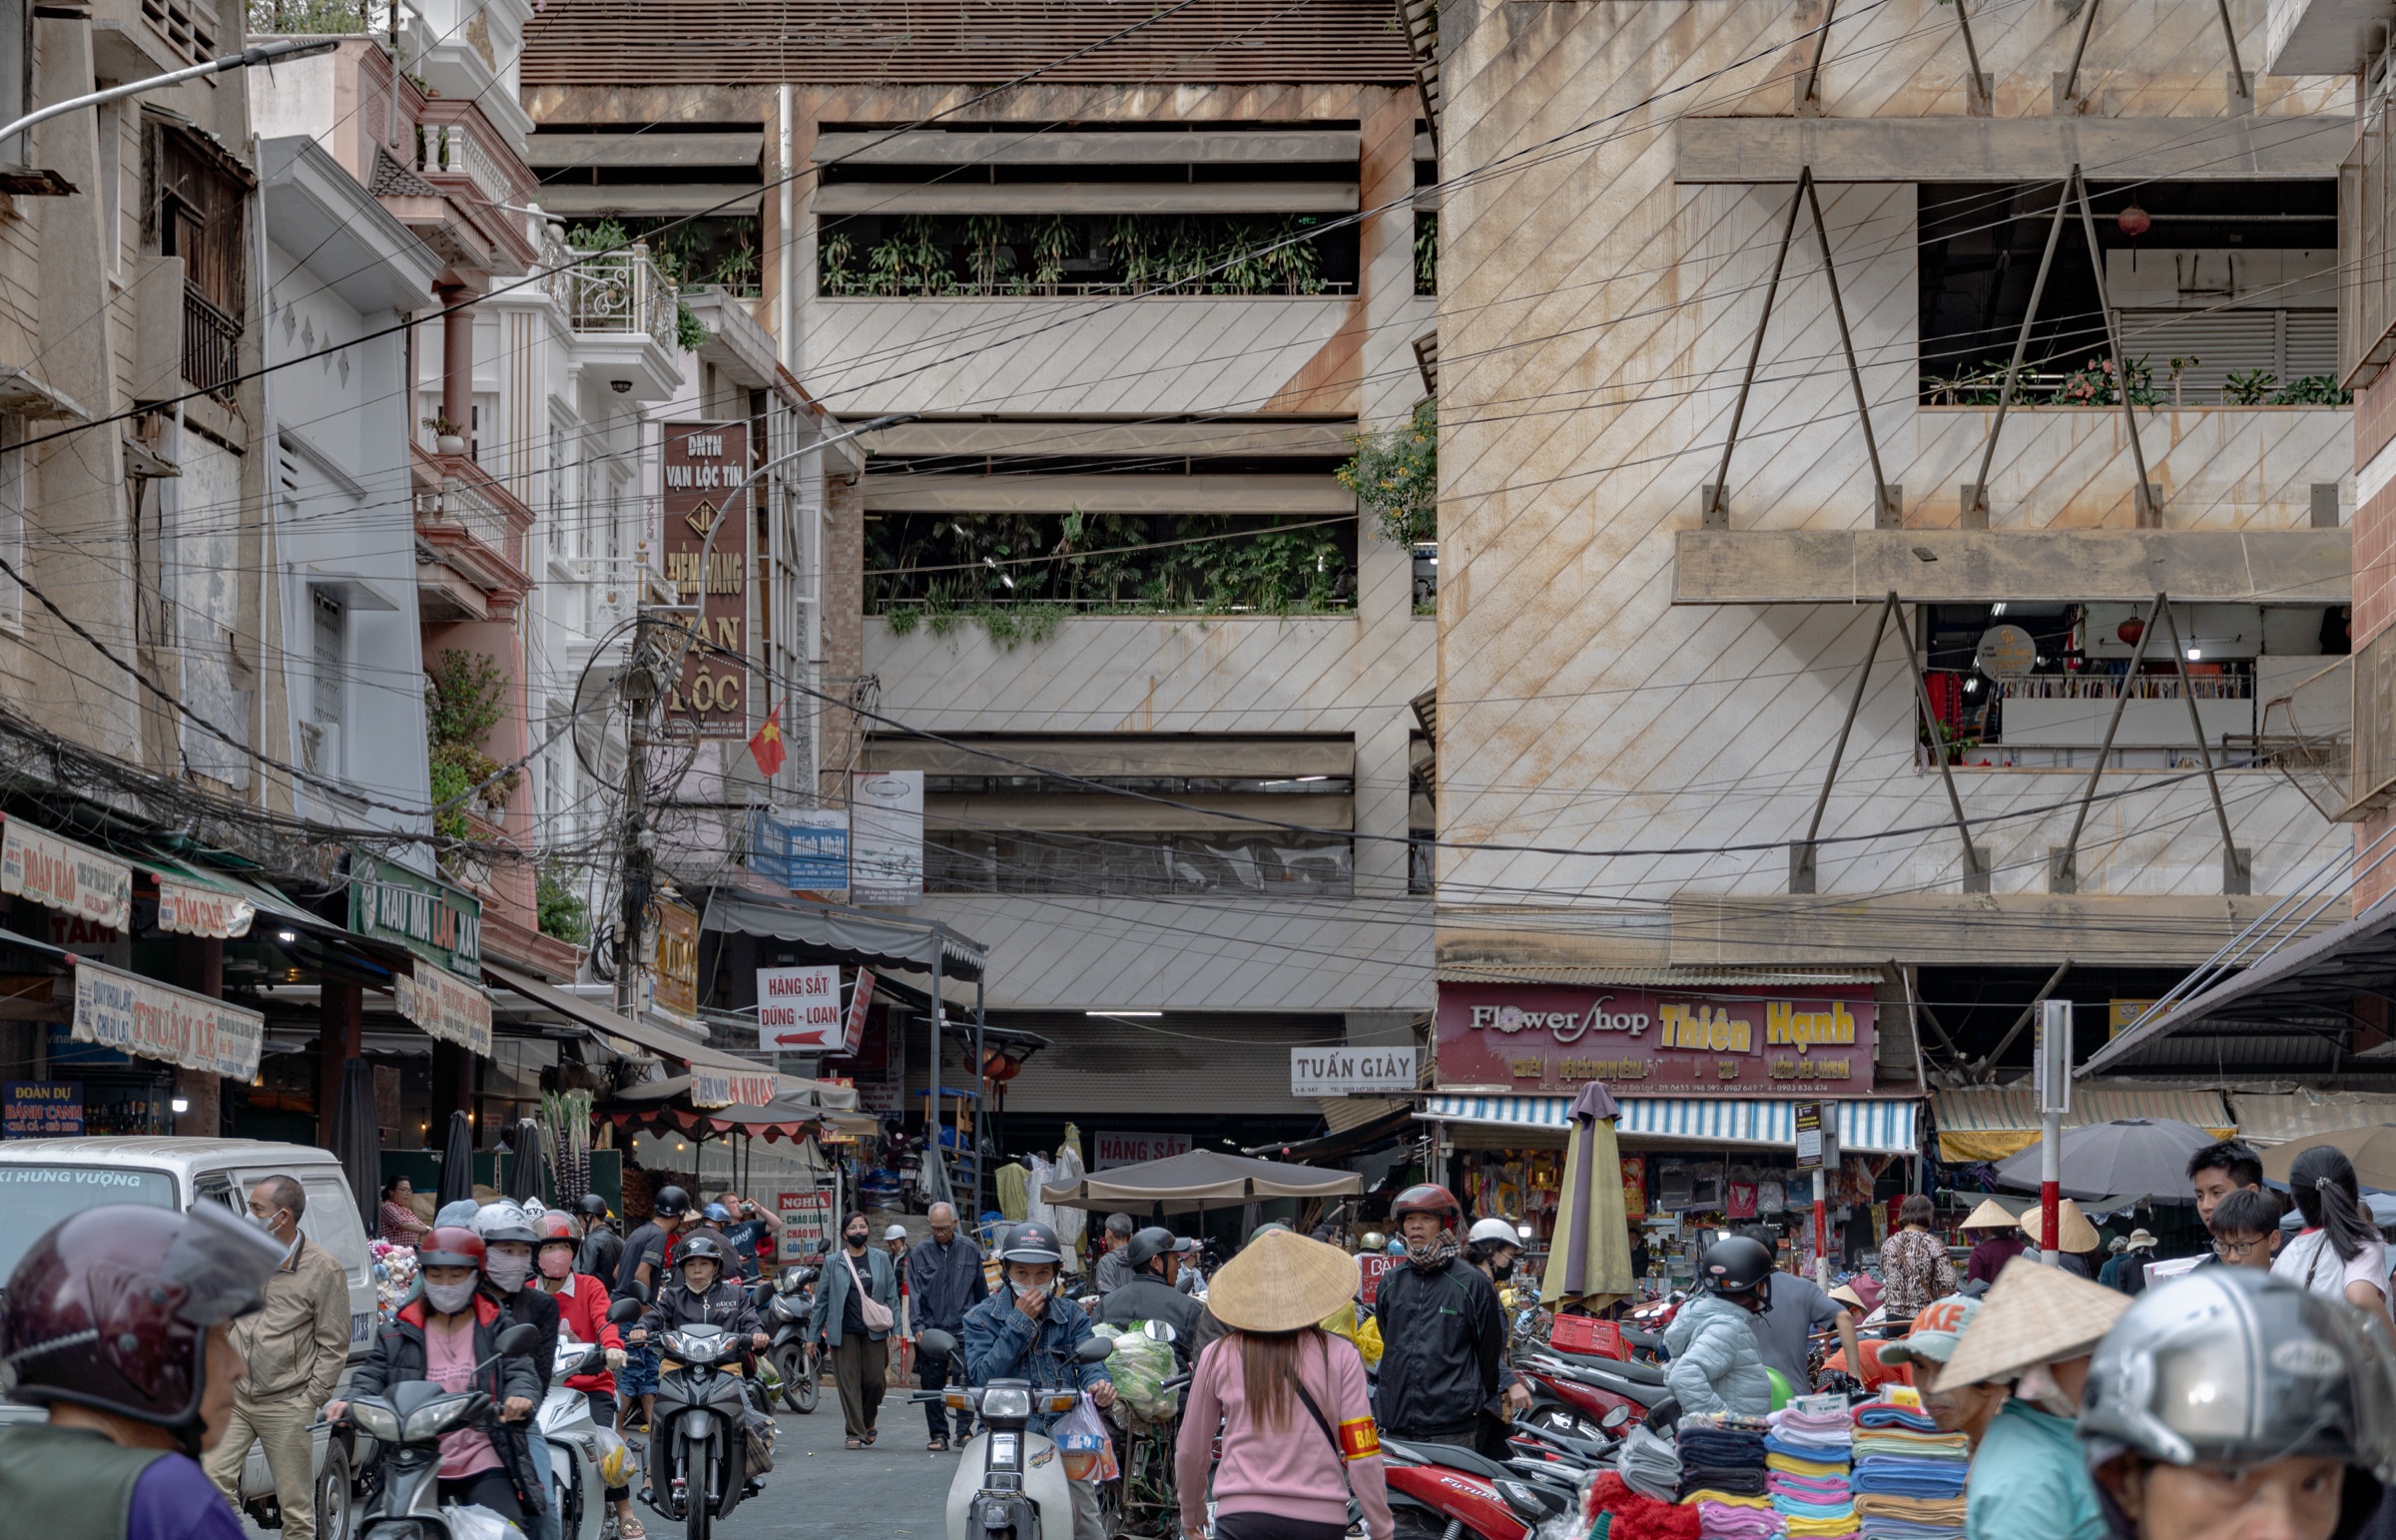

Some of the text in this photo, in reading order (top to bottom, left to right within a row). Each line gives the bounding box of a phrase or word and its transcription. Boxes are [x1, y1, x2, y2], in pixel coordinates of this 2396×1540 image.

[688, 435, 722, 458] DNTN
[666, 460, 743, 489] VẠN LỘC TÍN
[669, 664, 740, 721] LỘC
[793, 835, 845, 859] Minh Nhật
[381, 885, 407, 932] RAU
[410, 886, 430, 942] MÁ
[458, 911, 480, 961] XAY
[769, 971, 829, 996] HÀNG SẮT
[762, 1005, 795, 1026] DŨNG
[807, 1006, 838, 1024] LOAN
[1471, 1005, 1579, 1034] Flower
[1658, 1003, 1752, 1052] Thiên
[1767, 1001, 1856, 1054] Hạnh
[1298, 1051, 1410, 1078] TUẤN GIÀY
[15, 1085, 71, 1101] ĐOÀN DỰ
[1610, 1083, 1627, 1092] Chợ
[5, 1101, 82, 1119] BÁNH CANH
[27, 1119, 39, 1131] CÁ
[1100, 1135, 1186, 1161] HÀNG SẮT
[16, 1169, 71, 1183] HƯNG
[75, 1171, 141, 1187] VƯỢNG
[783, 1194, 827, 1209] NGHĨA
[787, 1213, 807, 1226] CHÁO
[787, 1228, 807, 1240] CHÁO
[1355, 1423, 1379, 1449] BẢO
